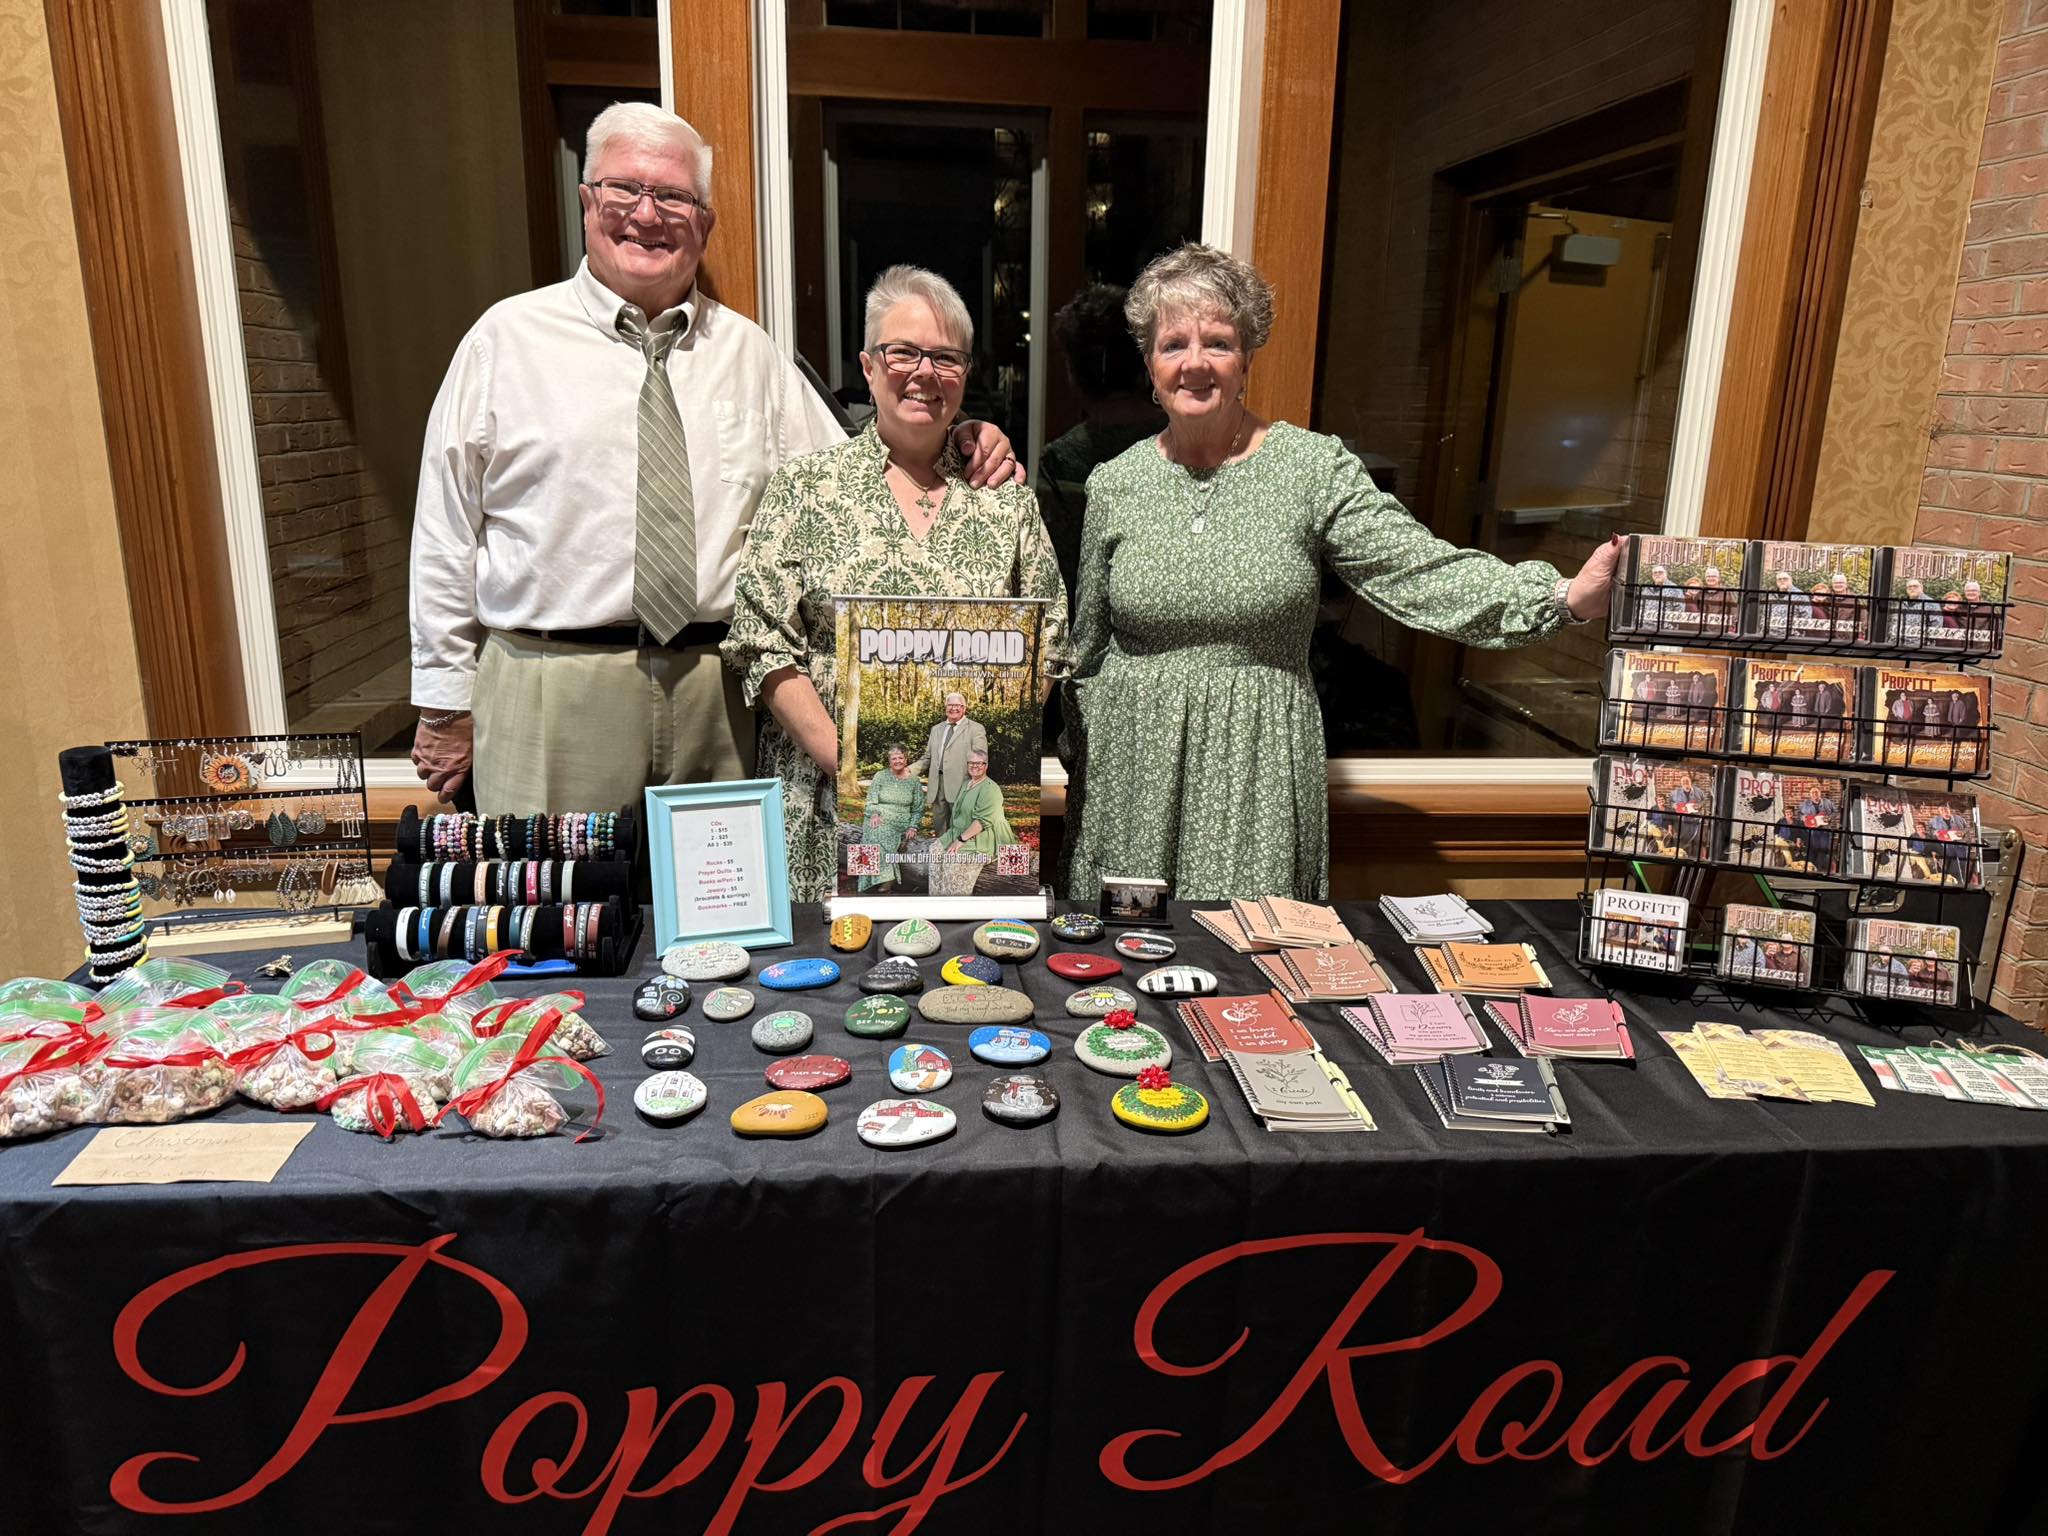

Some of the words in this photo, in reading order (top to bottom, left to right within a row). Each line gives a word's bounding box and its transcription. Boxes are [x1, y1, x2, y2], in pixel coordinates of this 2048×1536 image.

[859, 628, 949, 663] POPPY
[952, 630, 1026, 664] ROAD
[1881, 671, 1937, 690] PROFITT
[1607, 896, 1681, 916] PROFITT
[109, 1232, 1029, 1536] Poppy
[1099, 1228, 1895, 1492] Road
